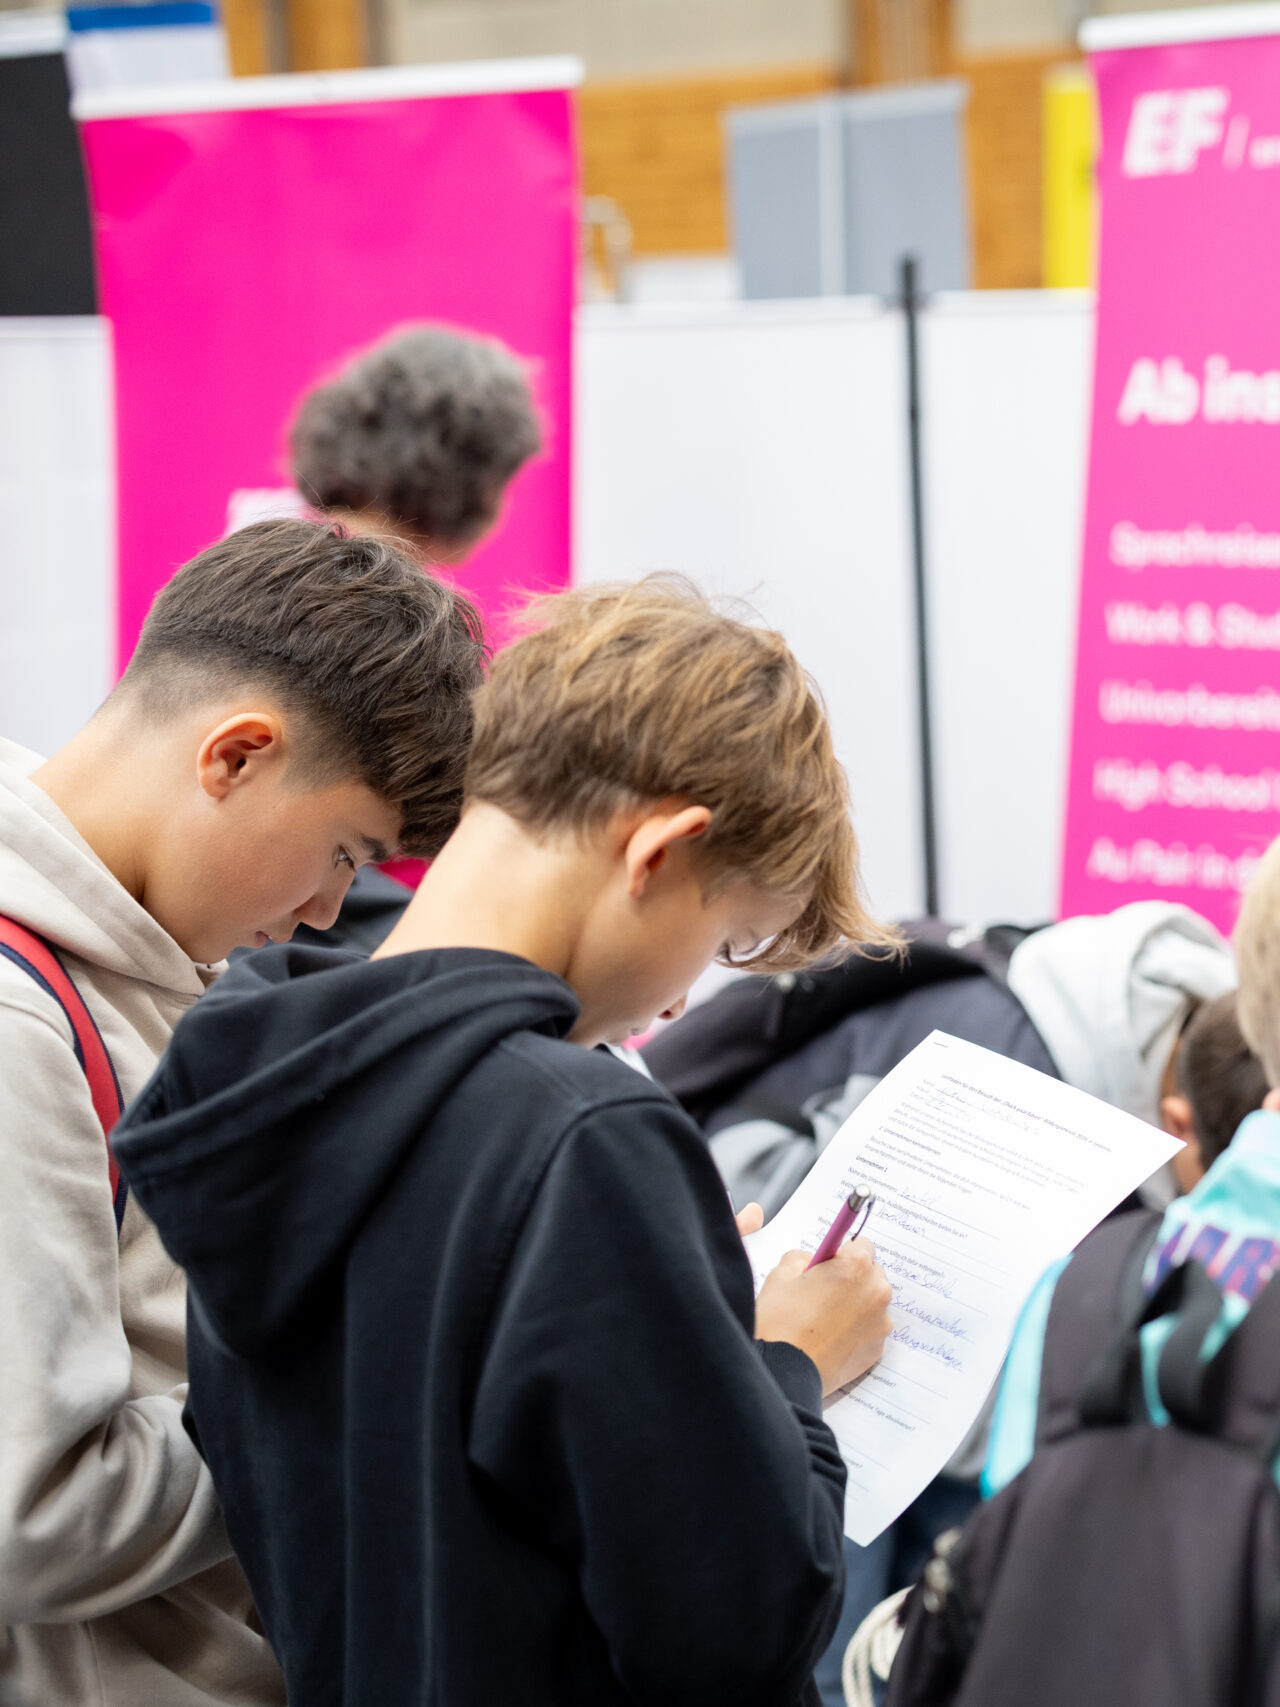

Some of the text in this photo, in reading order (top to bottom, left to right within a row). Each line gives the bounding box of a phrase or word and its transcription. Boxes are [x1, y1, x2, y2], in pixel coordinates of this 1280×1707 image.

[1123, 88, 1230, 178] EF
[1118, 358, 1200, 425] Ab
[1184, 602, 1214, 647] &
[856, 1156, 884, 1170] Unternehmen
